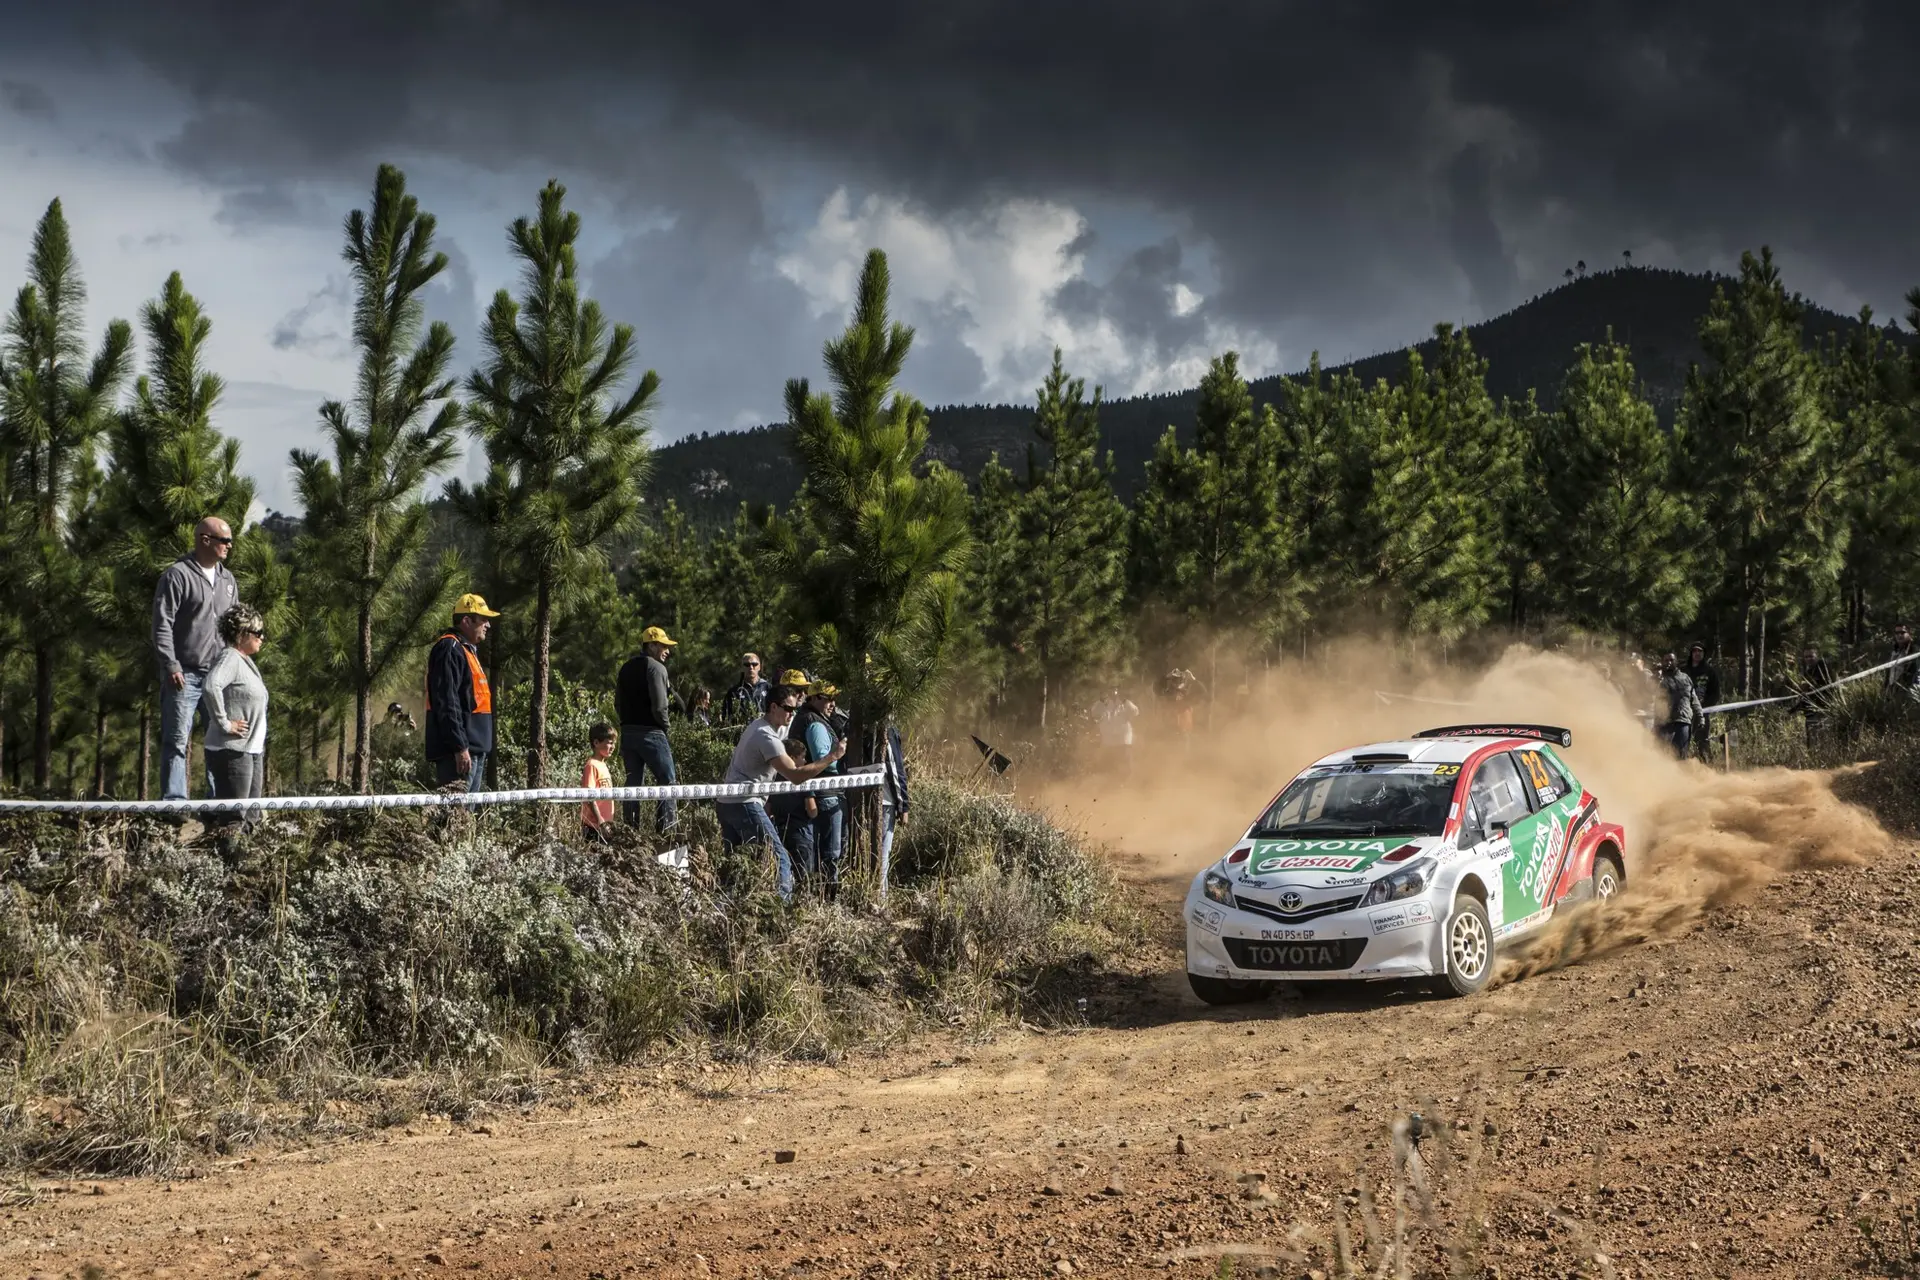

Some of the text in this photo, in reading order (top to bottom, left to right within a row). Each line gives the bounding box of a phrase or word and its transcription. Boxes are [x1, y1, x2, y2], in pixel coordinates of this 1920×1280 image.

[1438, 728, 1542, 738] TOYOTA
[1434, 764, 1461, 776] 23
[1521, 750, 1549, 789] 23
[1259, 841, 1386, 854] TOYOTA
[1280, 856, 1358, 869] Castrol
[1518, 821, 1550, 898] TOYOTA
[1374, 914, 1405, 925] FINANCIAL
[1411, 915, 1432, 923] TOYOTA
[1375, 920, 1405, 931] SERVICES
[1261, 930, 1272, 940] CN
[1285, 930, 1296, 940] PS
[1303, 930, 1315, 940] GP
[1247, 946, 1333, 964] TOYOTA
